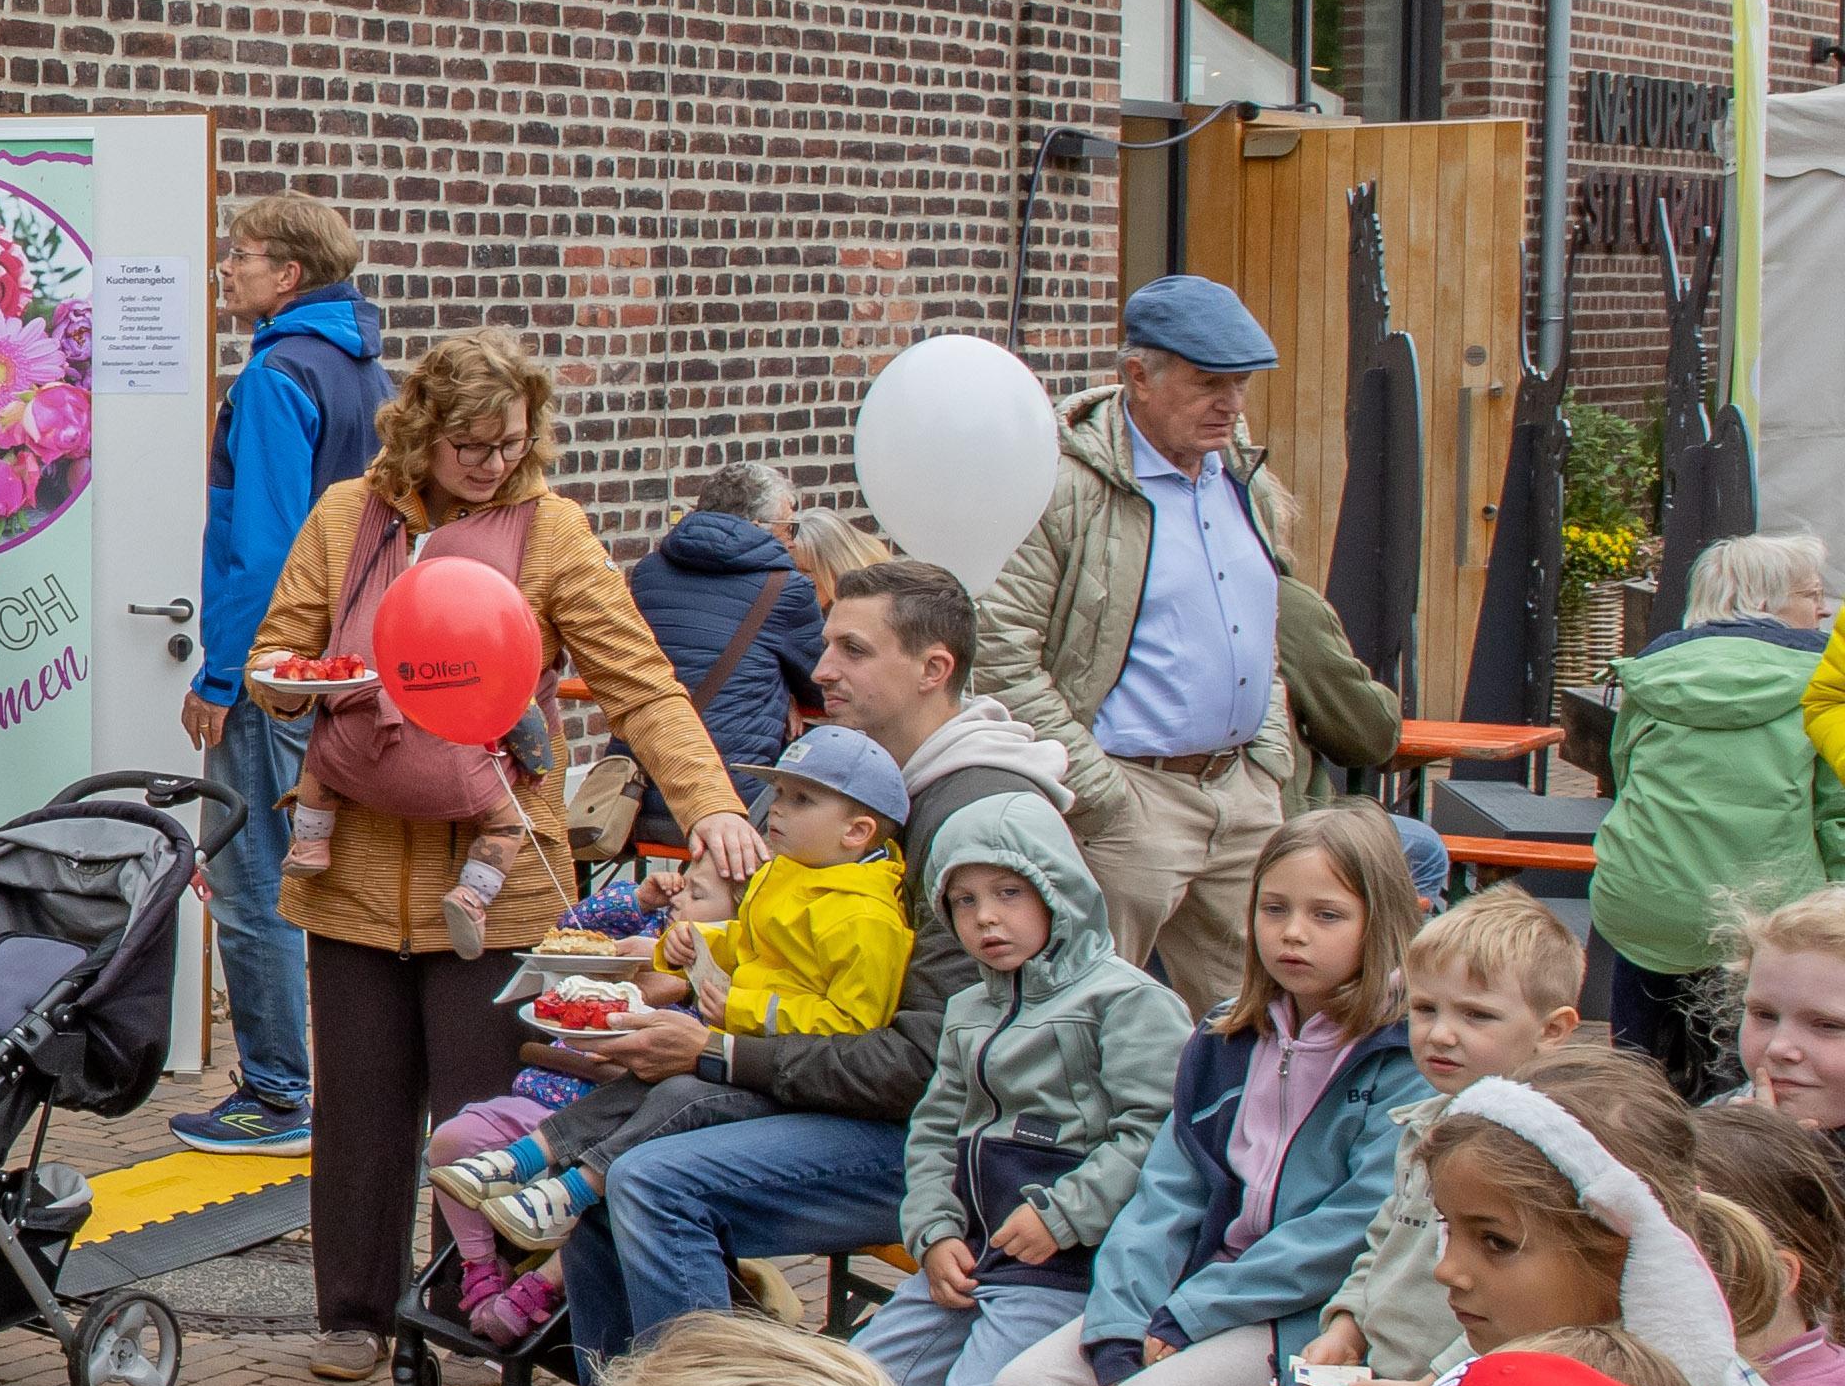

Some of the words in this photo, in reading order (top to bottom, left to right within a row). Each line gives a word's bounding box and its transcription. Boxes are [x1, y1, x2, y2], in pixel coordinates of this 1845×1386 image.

[1588, 71, 1731, 152] NATURPAR
[120, 265, 152, 274] Torten-
[154, 265, 161, 274] &
[106, 277, 176, 286] Kuchenangebot
[419, 662, 477, 680] Olfen
